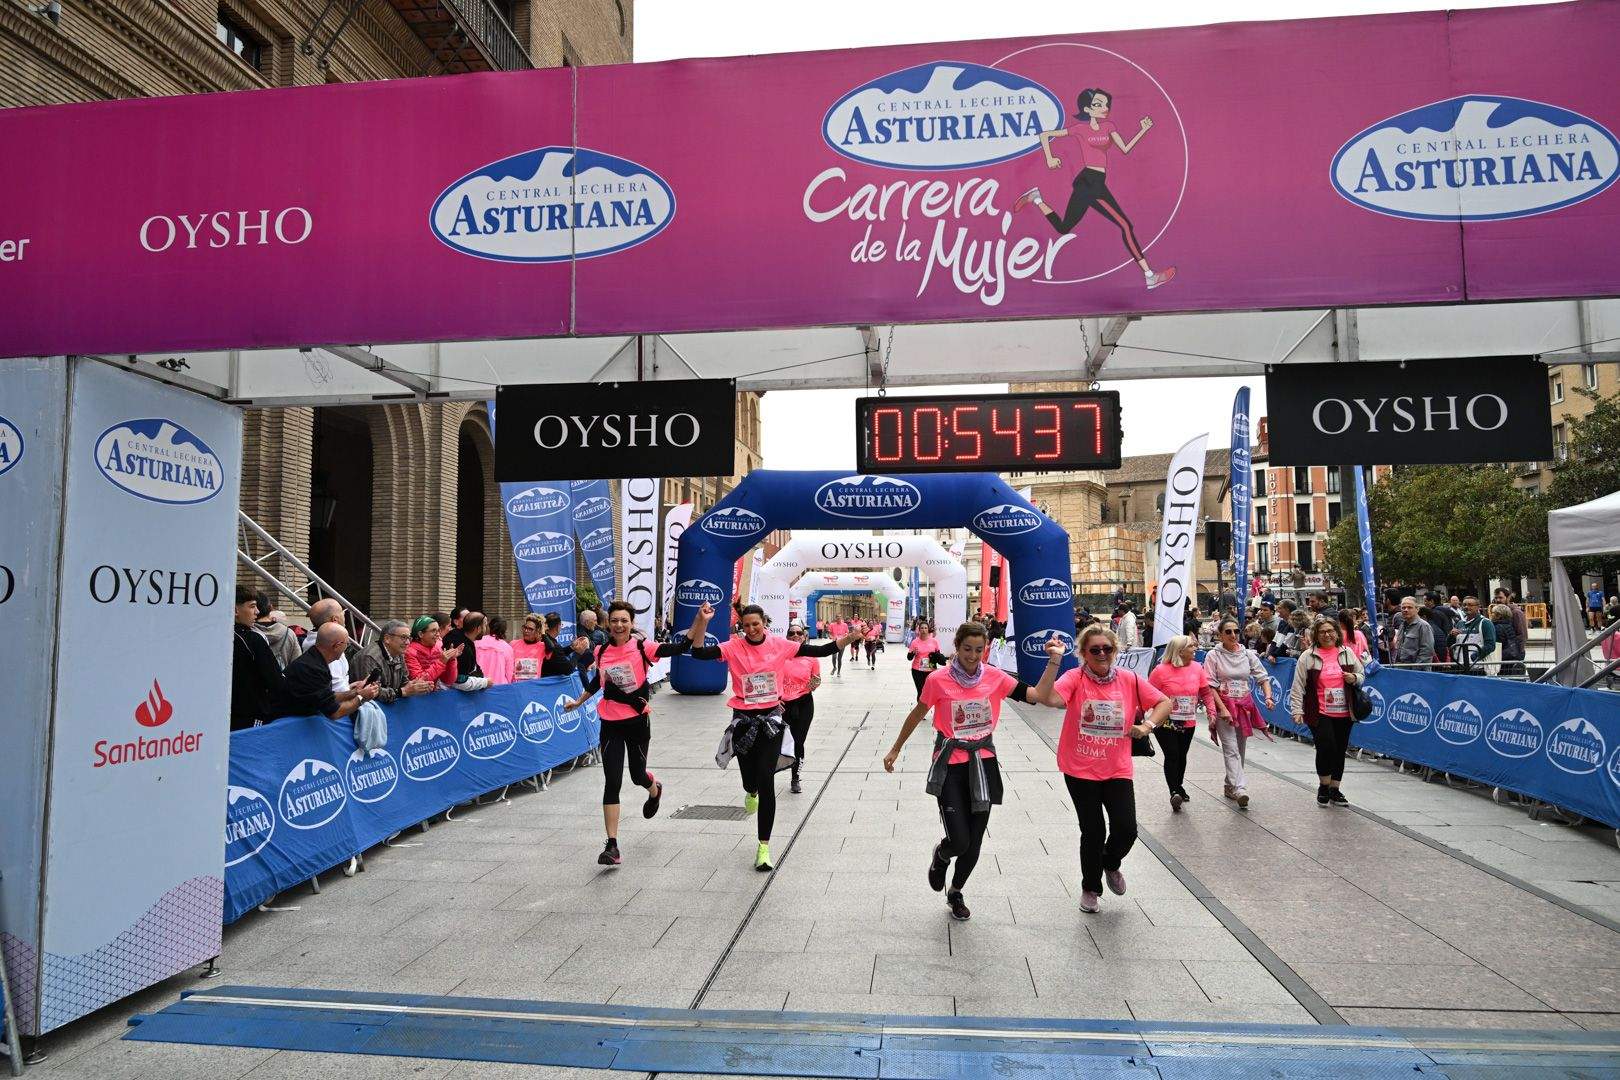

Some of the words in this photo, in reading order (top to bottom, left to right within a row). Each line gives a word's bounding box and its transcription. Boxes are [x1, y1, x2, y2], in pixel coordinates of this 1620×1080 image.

[877, 99, 953, 114] CENTRAL
[960, 95, 1037, 109] LECHERA
[841, 105, 1045, 146] ASTURIANA
[1396, 138, 1487, 155] CENTRAL
[1496, 132, 1591, 148] LECHERA
[1353, 147, 1603, 194] ASTURIANA
[486, 185, 562, 201] CENTRAL
[568, 180, 650, 198] LECHERA
[803, 167, 1000, 223] Carrera
[139, 206, 313, 253] OYSHO
[447, 193, 656, 238] ASTURIANA
[850, 224, 887, 263] de
[895, 214, 922, 263] la
[915, 211, 1078, 306] Mujer
[1312, 393, 1509, 435] OYSHO
[533, 412, 701, 449] OYSHO
[104, 438, 217, 491] ASTURIANA
[128, 439, 171, 459] CENTRAL
[173, 449, 214, 468] LECHERA
[823, 488, 915, 508] ASTURIANA
[704, 517, 761, 531] ASTURIANA
[979, 515, 1039, 530] ASTURIANA
[627, 478, 656, 615] OYSHO
[821, 541, 904, 559] OYSHO
[1160, 466, 1200, 609] OYSHO
[88, 564, 219, 607] OYSHO
[1022, 587, 1070, 601] ASTURIANA
[1389, 704, 1428, 727] ASTURIANA
[1437, 712, 1479, 737] ASTURIANA
[93, 729, 204, 769] Santander
[468, 729, 516, 752] ASTURIANA
[1487, 722, 1539, 749] ASTURIANA
[405, 745, 458, 774] ASTURIANA
[350, 765, 398, 794] ASTURIANA
[285, 782, 345, 820] ASTURIANA
